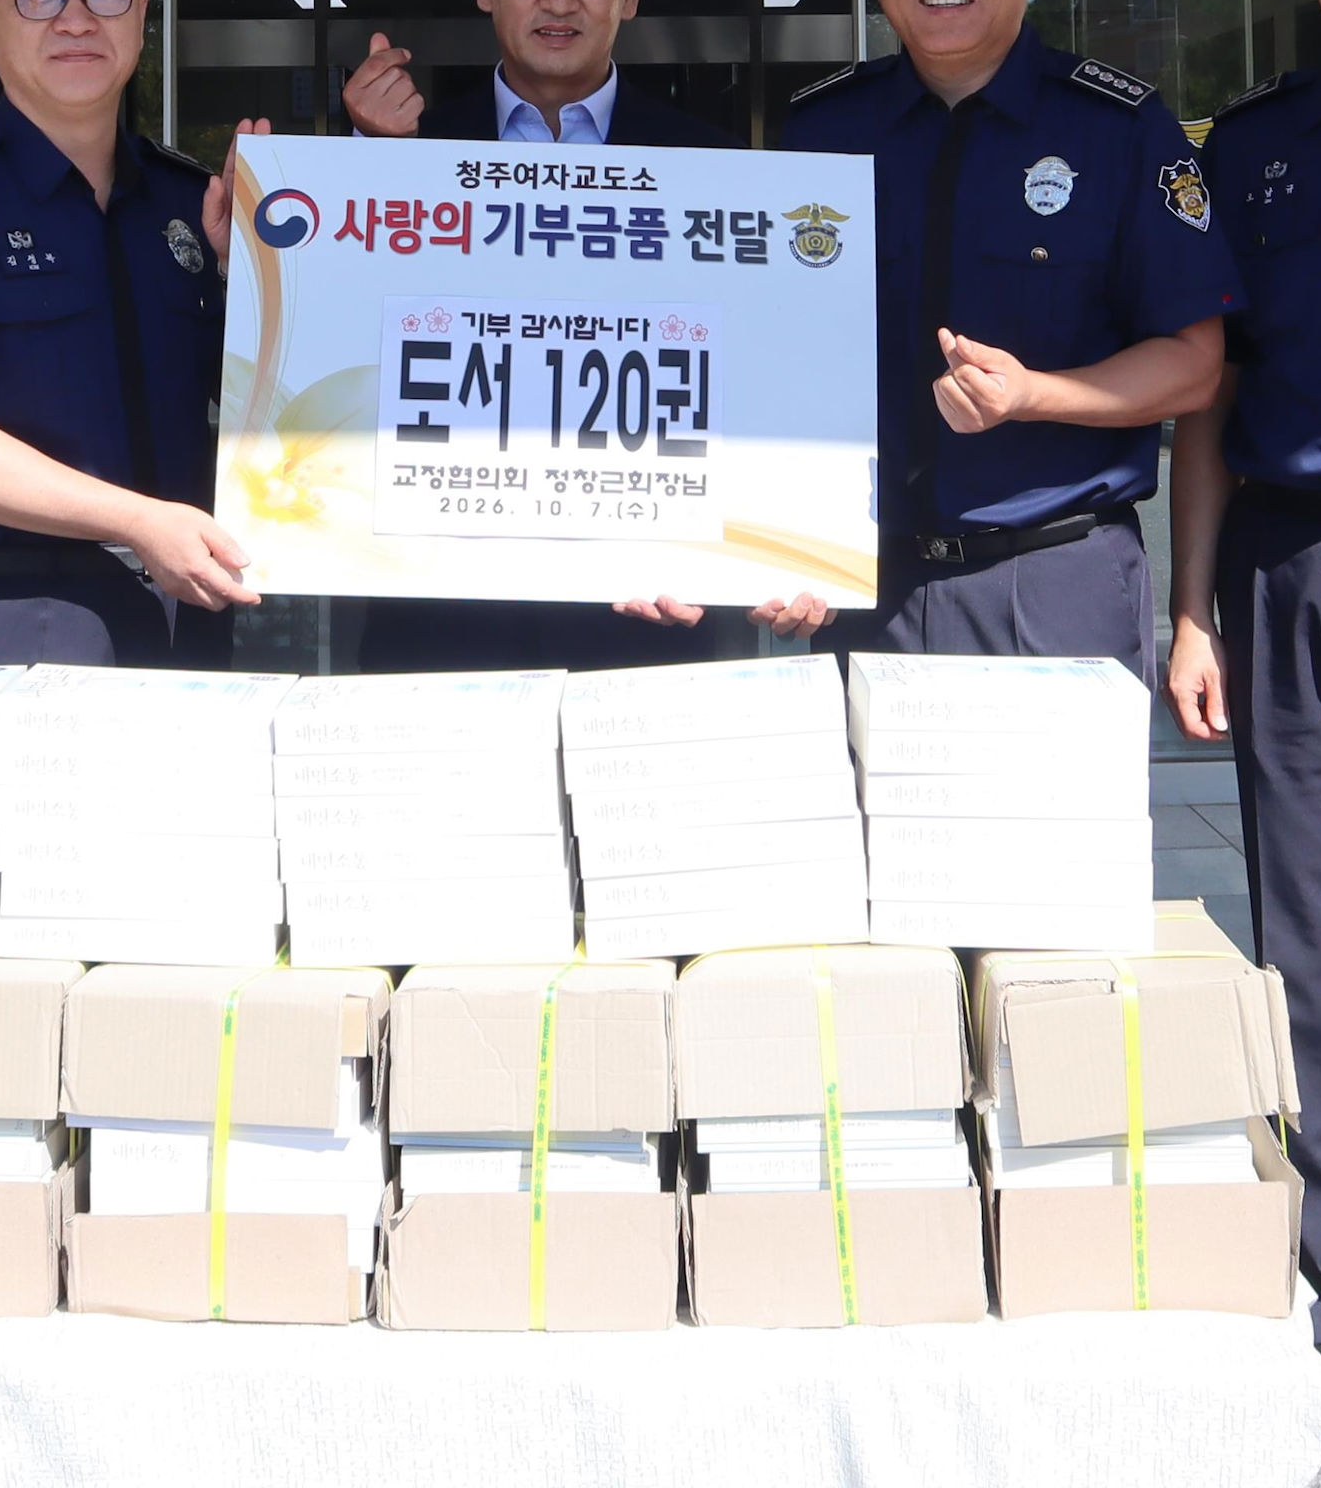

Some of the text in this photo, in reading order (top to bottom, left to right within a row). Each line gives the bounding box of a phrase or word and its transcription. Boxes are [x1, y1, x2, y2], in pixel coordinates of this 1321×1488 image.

[455, 159, 659, 192] 청주여자교도소
[333, 197, 473, 255] 사랑의
[482, 202, 671, 262] 기부금품
[682, 208, 774, 266] 전달
[460, 311, 651, 343] 기부 감사합니다
[396, 339, 710, 458] 도서 120권
[392, 464, 707, 497] 교정협의회 정창근회장님
[439, 496, 515, 515] 2026.
[535, 500, 574, 517] 10.
